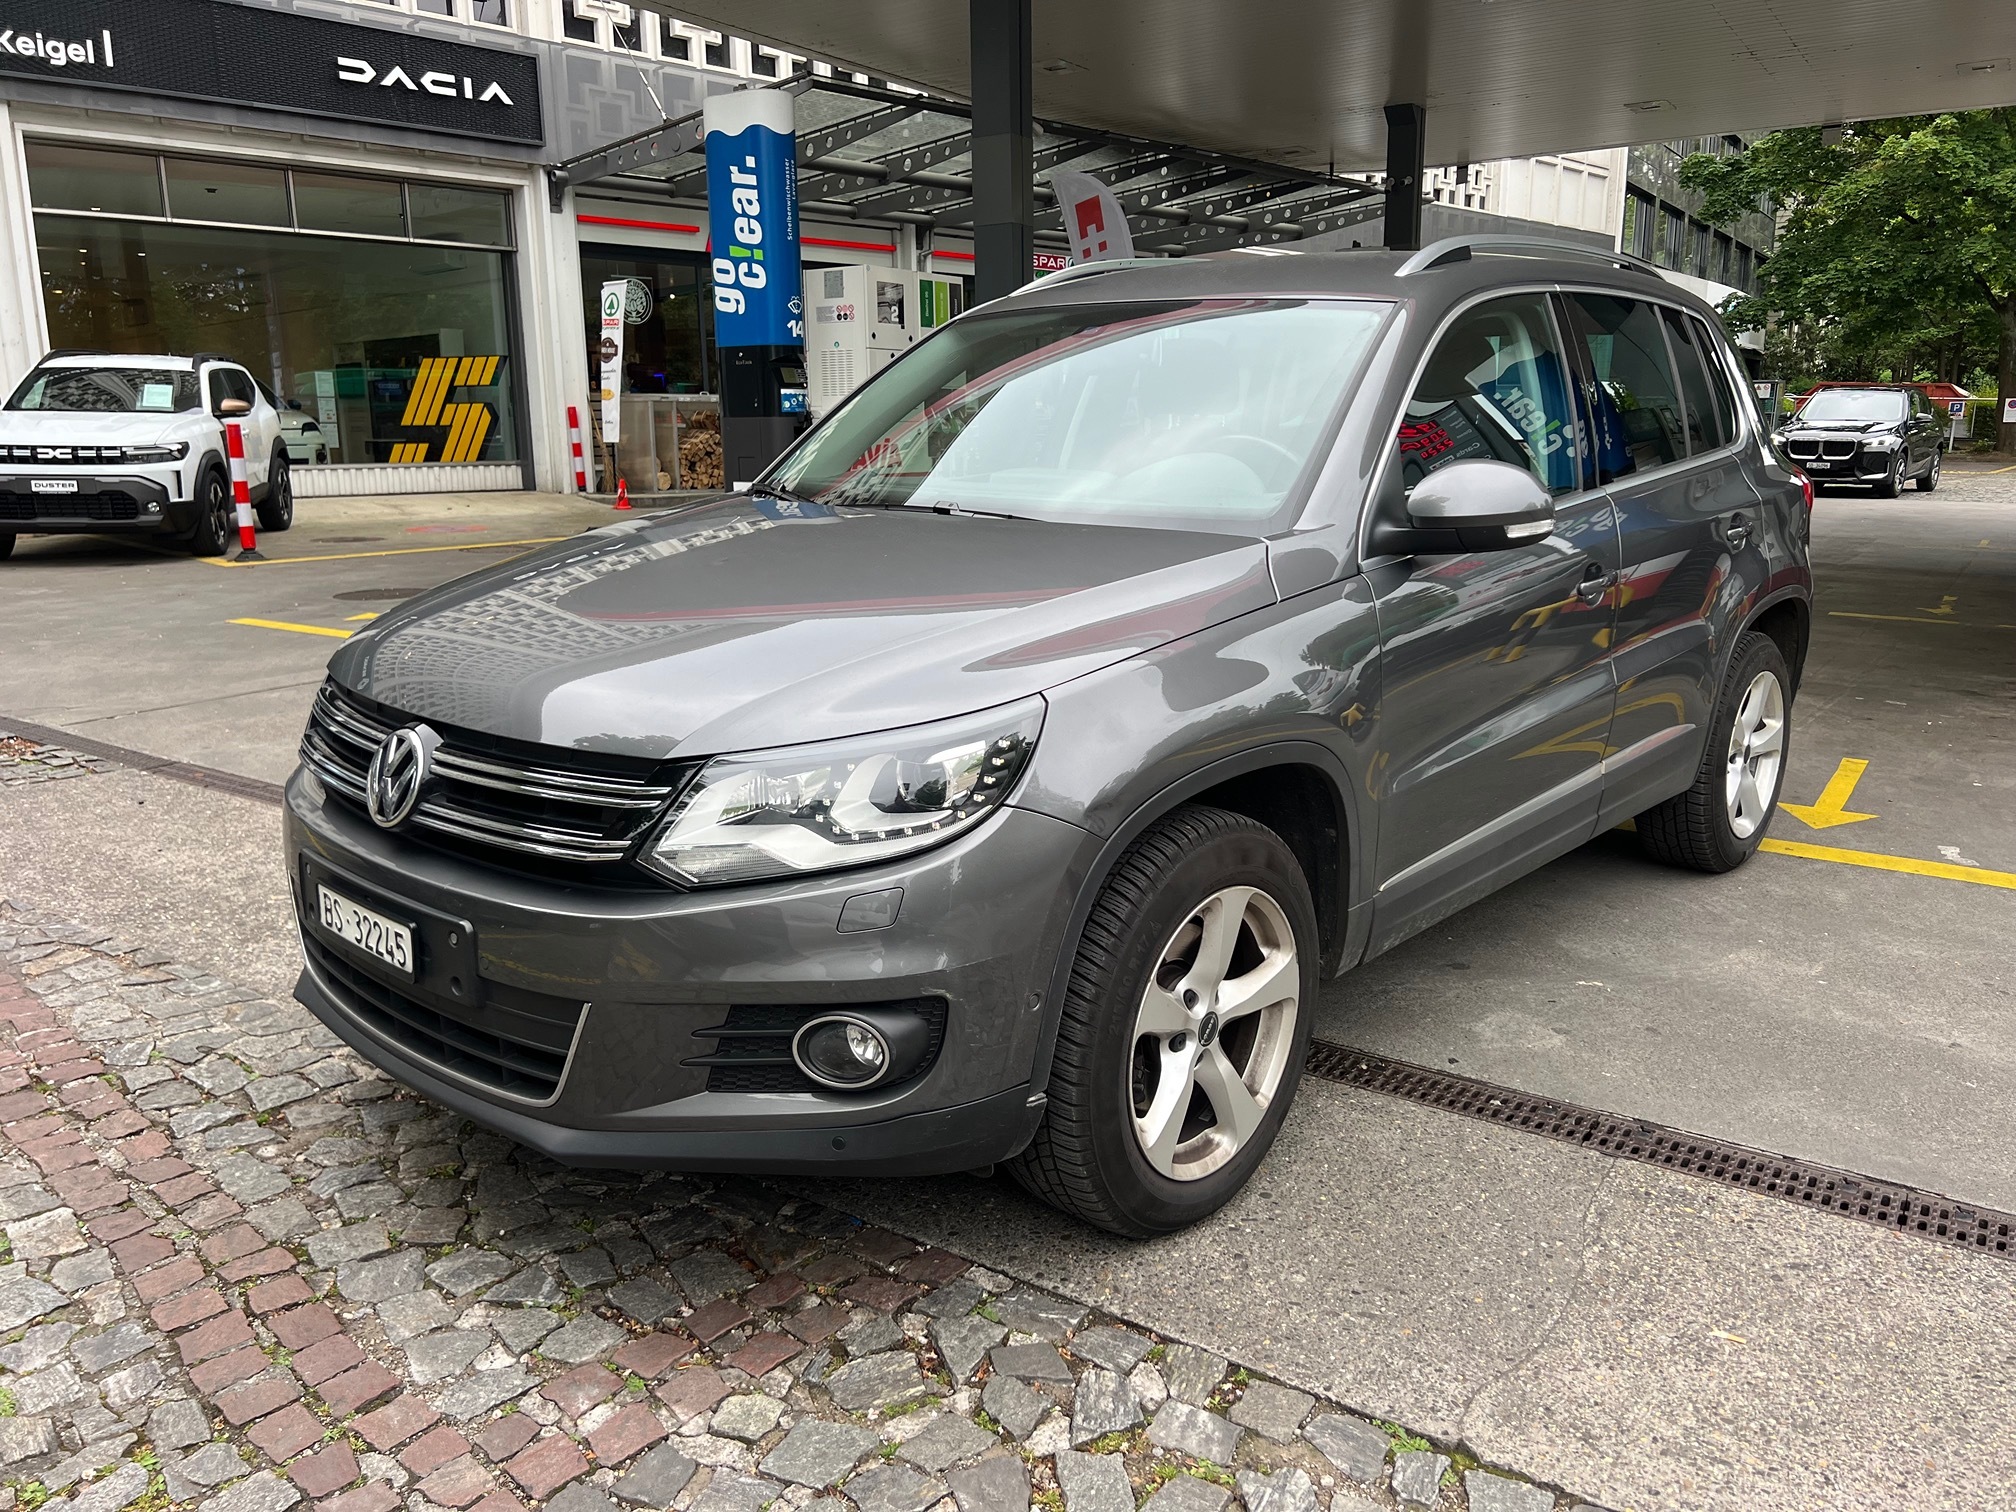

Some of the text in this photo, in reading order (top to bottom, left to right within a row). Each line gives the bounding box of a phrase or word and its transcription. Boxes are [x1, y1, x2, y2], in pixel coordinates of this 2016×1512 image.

[0, 30, 95, 66] Keigel
[337, 56, 515, 106] DACIA
[784, 157, 794, 241] Scheibenwischwasser
[1033, 255, 1067, 269] SPAR
[713, 258, 746, 315] go
[891, 305, 899, 322] 2
[1953, 403, 1961, 412] P
[353, 909, 407, 967] 32245
